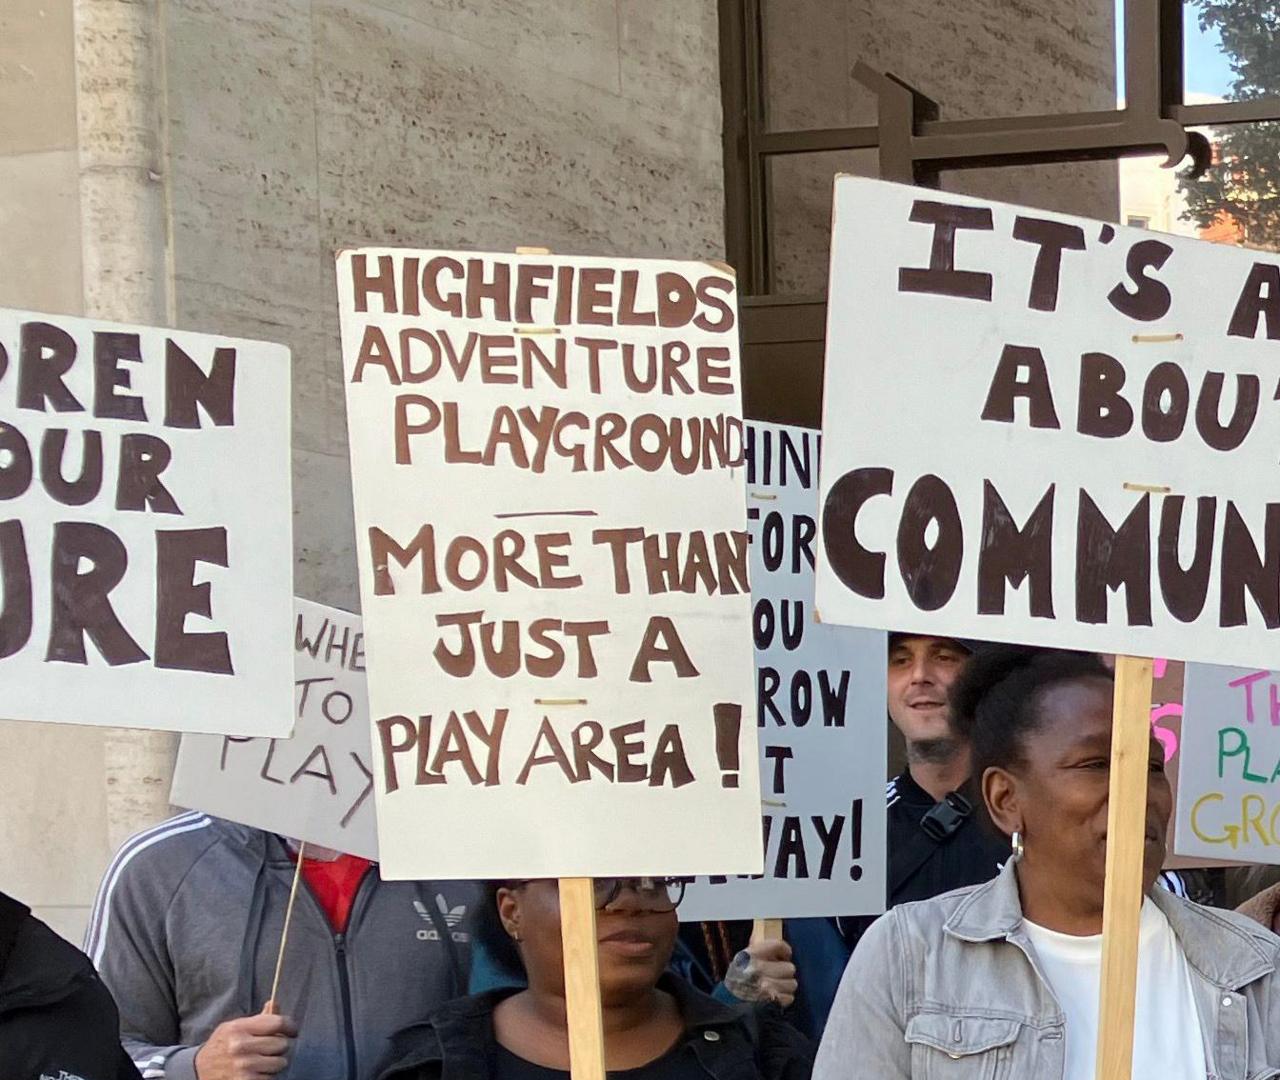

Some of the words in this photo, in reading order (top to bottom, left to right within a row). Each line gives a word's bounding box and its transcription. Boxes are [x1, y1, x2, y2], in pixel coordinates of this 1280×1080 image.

[351, 254, 735, 333] HIGHFIELDS
[898, 200, 1173, 321] IT'S
[0, 322, 237, 430] REN
[351, 325, 734, 395] ADVENTURE
[395, 394, 744, 474] PLAYGROUND
[368, 524, 583, 595] MORE
[592, 527, 750, 595] THAN
[433, 611, 611, 679] JUST
[629, 616, 700, 682] A
[295, 677, 353, 724] TO
[376, 708, 509, 794] PLAY
